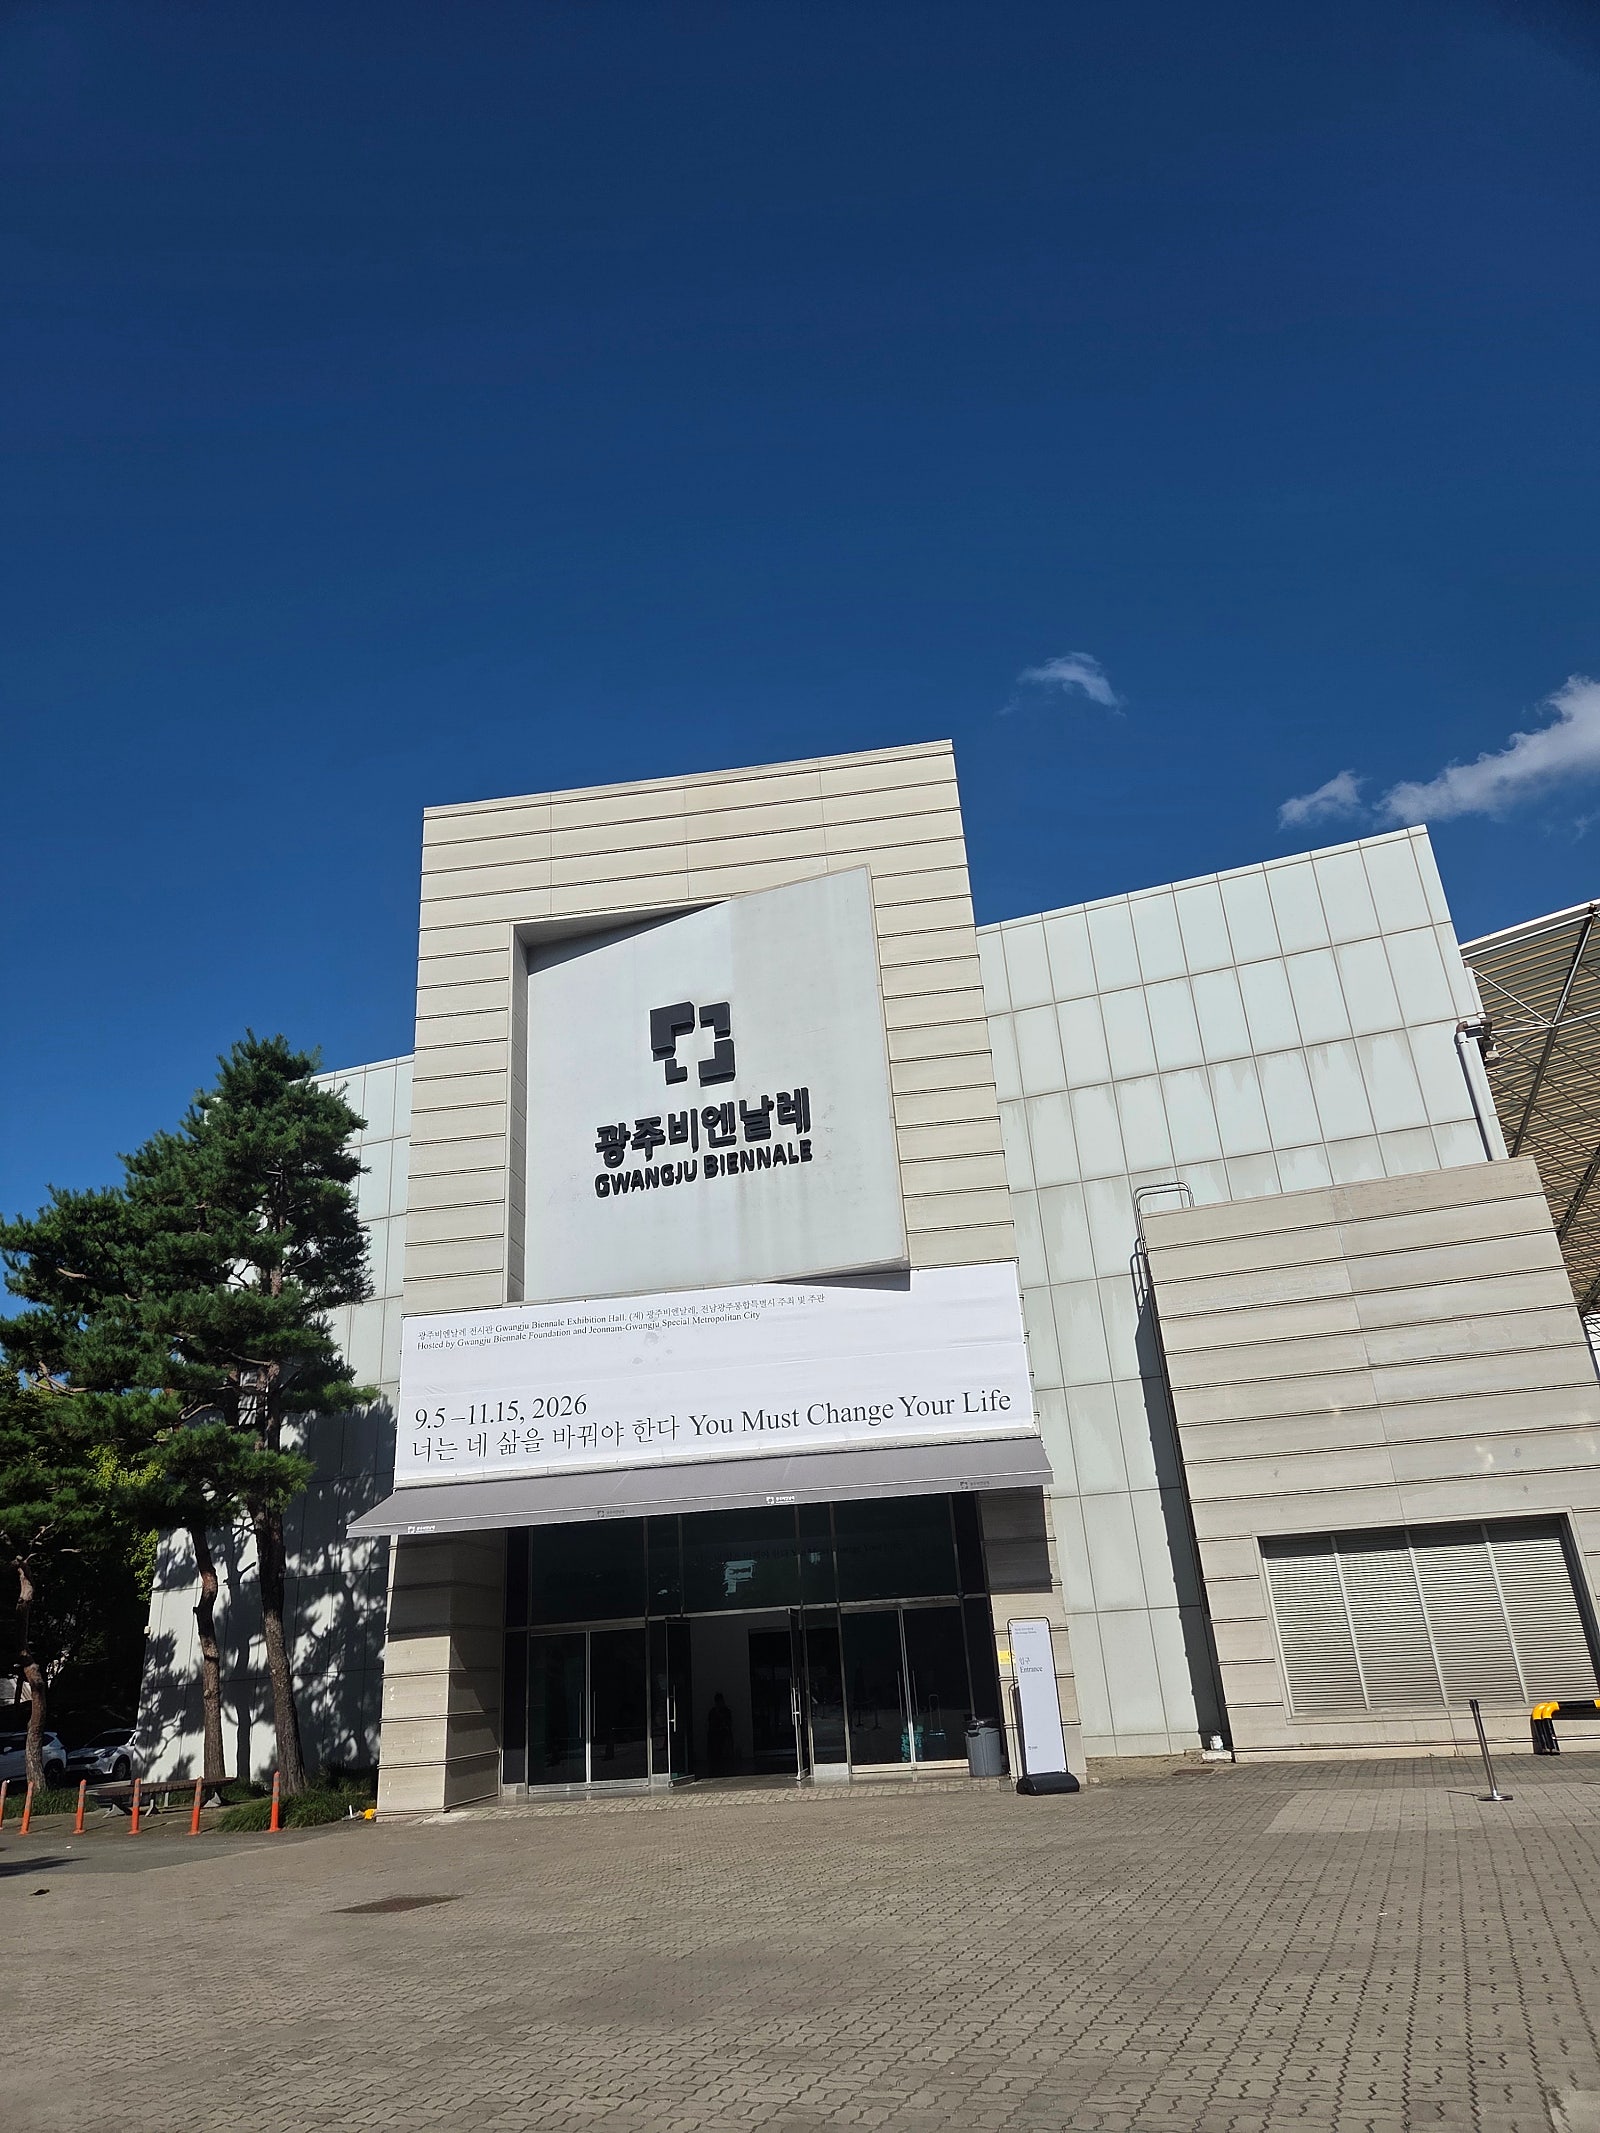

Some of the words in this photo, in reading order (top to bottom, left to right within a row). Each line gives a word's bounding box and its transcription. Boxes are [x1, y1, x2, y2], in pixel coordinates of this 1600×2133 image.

[595, 1087, 812, 1168] 광주비엔날레
[595, 1159, 698, 1198] GWANGJU
[704, 1139, 813, 1180] BIENNALE
[417, 1340, 444, 1351] Hosted
[445, 1341, 455, 1350] by
[457, 1335, 491, 1347] Gwangju
[493, 1332, 527, 1343] Biennale
[529, 1328, 571, 1340] Foundation
[573, 1326, 587, 1336] and
[662, 1317, 690, 1328] Special
[692, 1312, 742, 1325] Metropolitan
[743, 1310, 761, 1321] City
[495, 1322, 529, 1332] Gwangju
[531, 1319, 565, 1329] Biennale
[567, 1315, 606, 1326] Exhibition
[412, 1437, 458, 1463] 너는
[467, 1432, 488, 1458] 네
[496, 1427, 545, 1455] 삶을
[552, 1420, 624, 1450] 바꿔야
[631, 1415, 681, 1443] 한다
[688, 1414, 733, 1436] You
[741, 1408, 801, 1432] Must
[807, 1402, 894, 1427] Change
[898, 1395, 955, 1418] Your
[961, 1389, 1012, 1413] Life
[532, 1393, 588, 1419] 2026
[1020, 1666, 1043, 1674] Entrance
